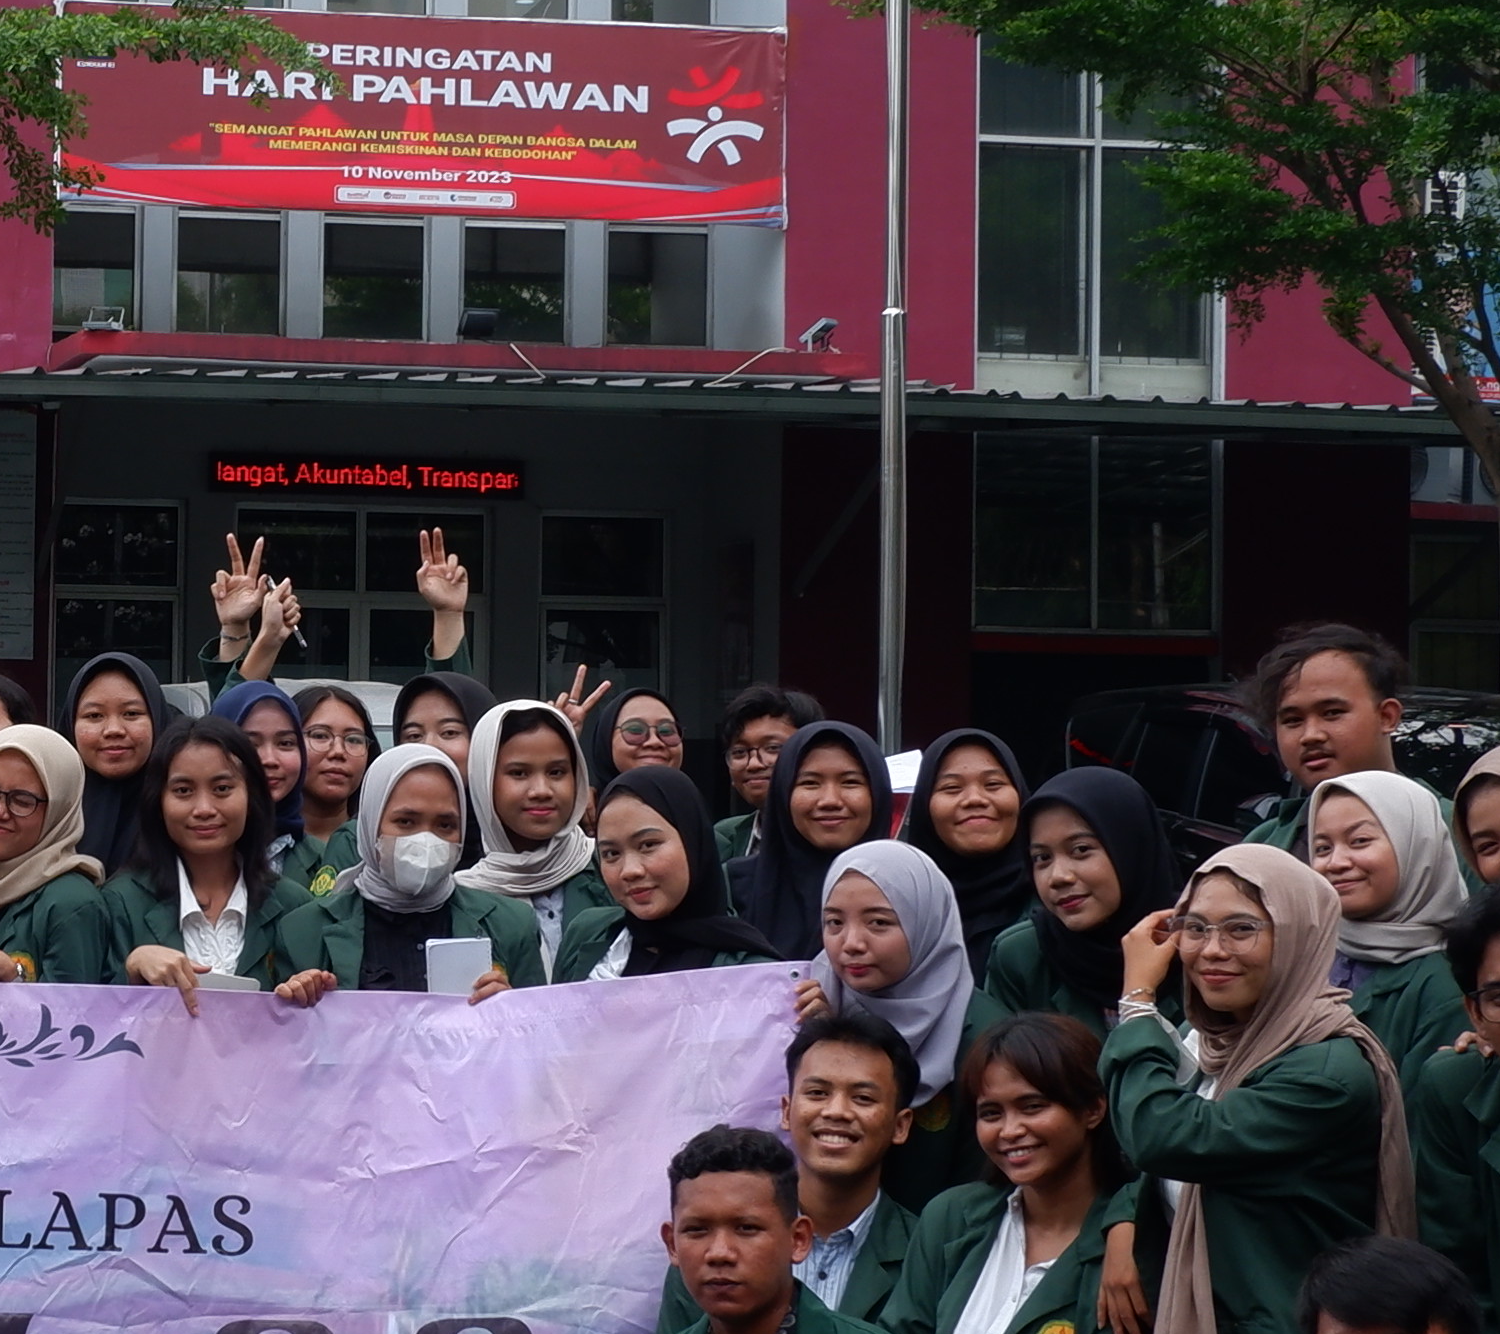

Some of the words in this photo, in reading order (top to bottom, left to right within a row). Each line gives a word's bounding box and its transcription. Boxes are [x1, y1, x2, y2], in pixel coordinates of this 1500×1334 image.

[306, 43, 552, 73] PERINGATAN
[353, 74, 649, 113] PAHLAWAN
[269, 140, 357, 152] MEMERANGI
[360, 143, 450, 156] KEMISKINAN
[452, 146, 481, 157] DAN
[485, 147, 577, 160] KEBODOHAN"
[299, 127, 377, 140] PAHLAWAN
[381, 131, 429, 142] UNTUK
[433, 132, 474, 143] MASA
[478, 134, 523, 145] DEPAN
[527, 135, 585, 147] BANGSA
[589, 138, 636, 149] DALAM
[342, 166, 363, 178] 10
[368, 167, 461, 182] November
[466, 170, 512, 183] 2023
[295, 463, 412, 489] Akuntabel,
[418, 466, 519, 493] Transpar
